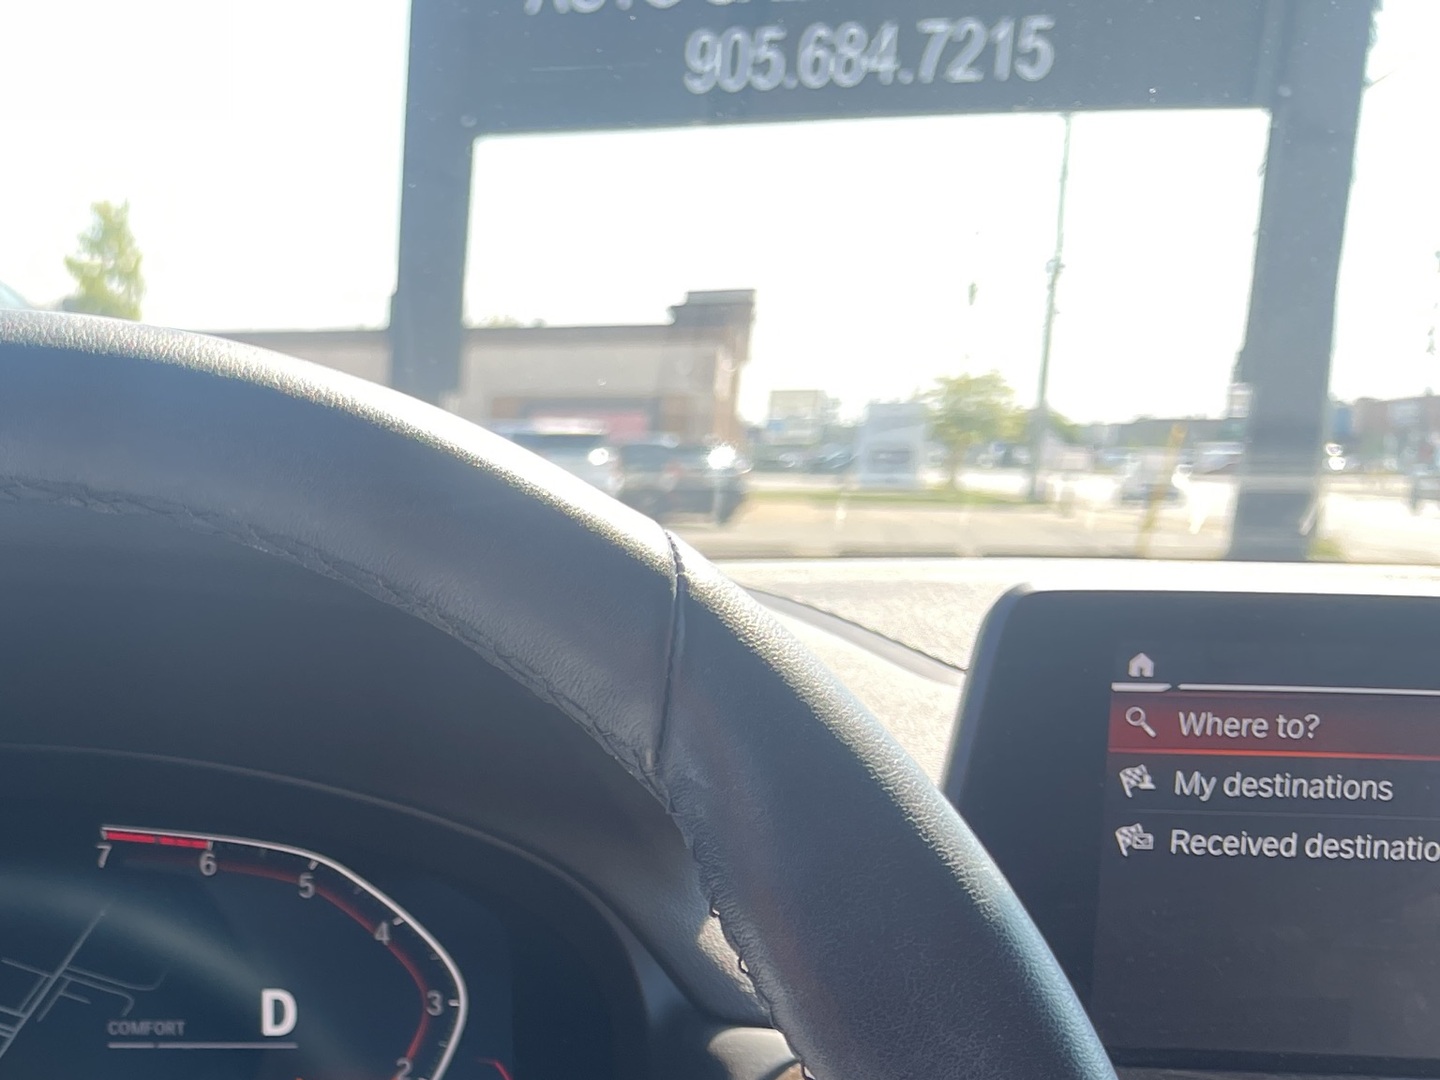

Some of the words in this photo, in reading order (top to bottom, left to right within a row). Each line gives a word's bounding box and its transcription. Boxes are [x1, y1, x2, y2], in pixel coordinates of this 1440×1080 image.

[684, 15, 1056, 93] 905.684.7215
[1178, 711, 1269, 738] Where
[1276, 713, 1321, 739] to?
[1174, 770, 1217, 801] My
[1223, 771, 1394, 801] destinations
[95, 842, 113, 869] 7
[1170, 828, 1298, 858] Received
[1305, 832, 1440, 862] destinatio
[199, 851, 218, 876] 6
[298, 873, 316, 899] 5
[373, 919, 391, 945] 4
[260, 987, 299, 1037] D
[425, 989, 444, 1016] 3
[107, 1019, 186, 1037] COMFORT
